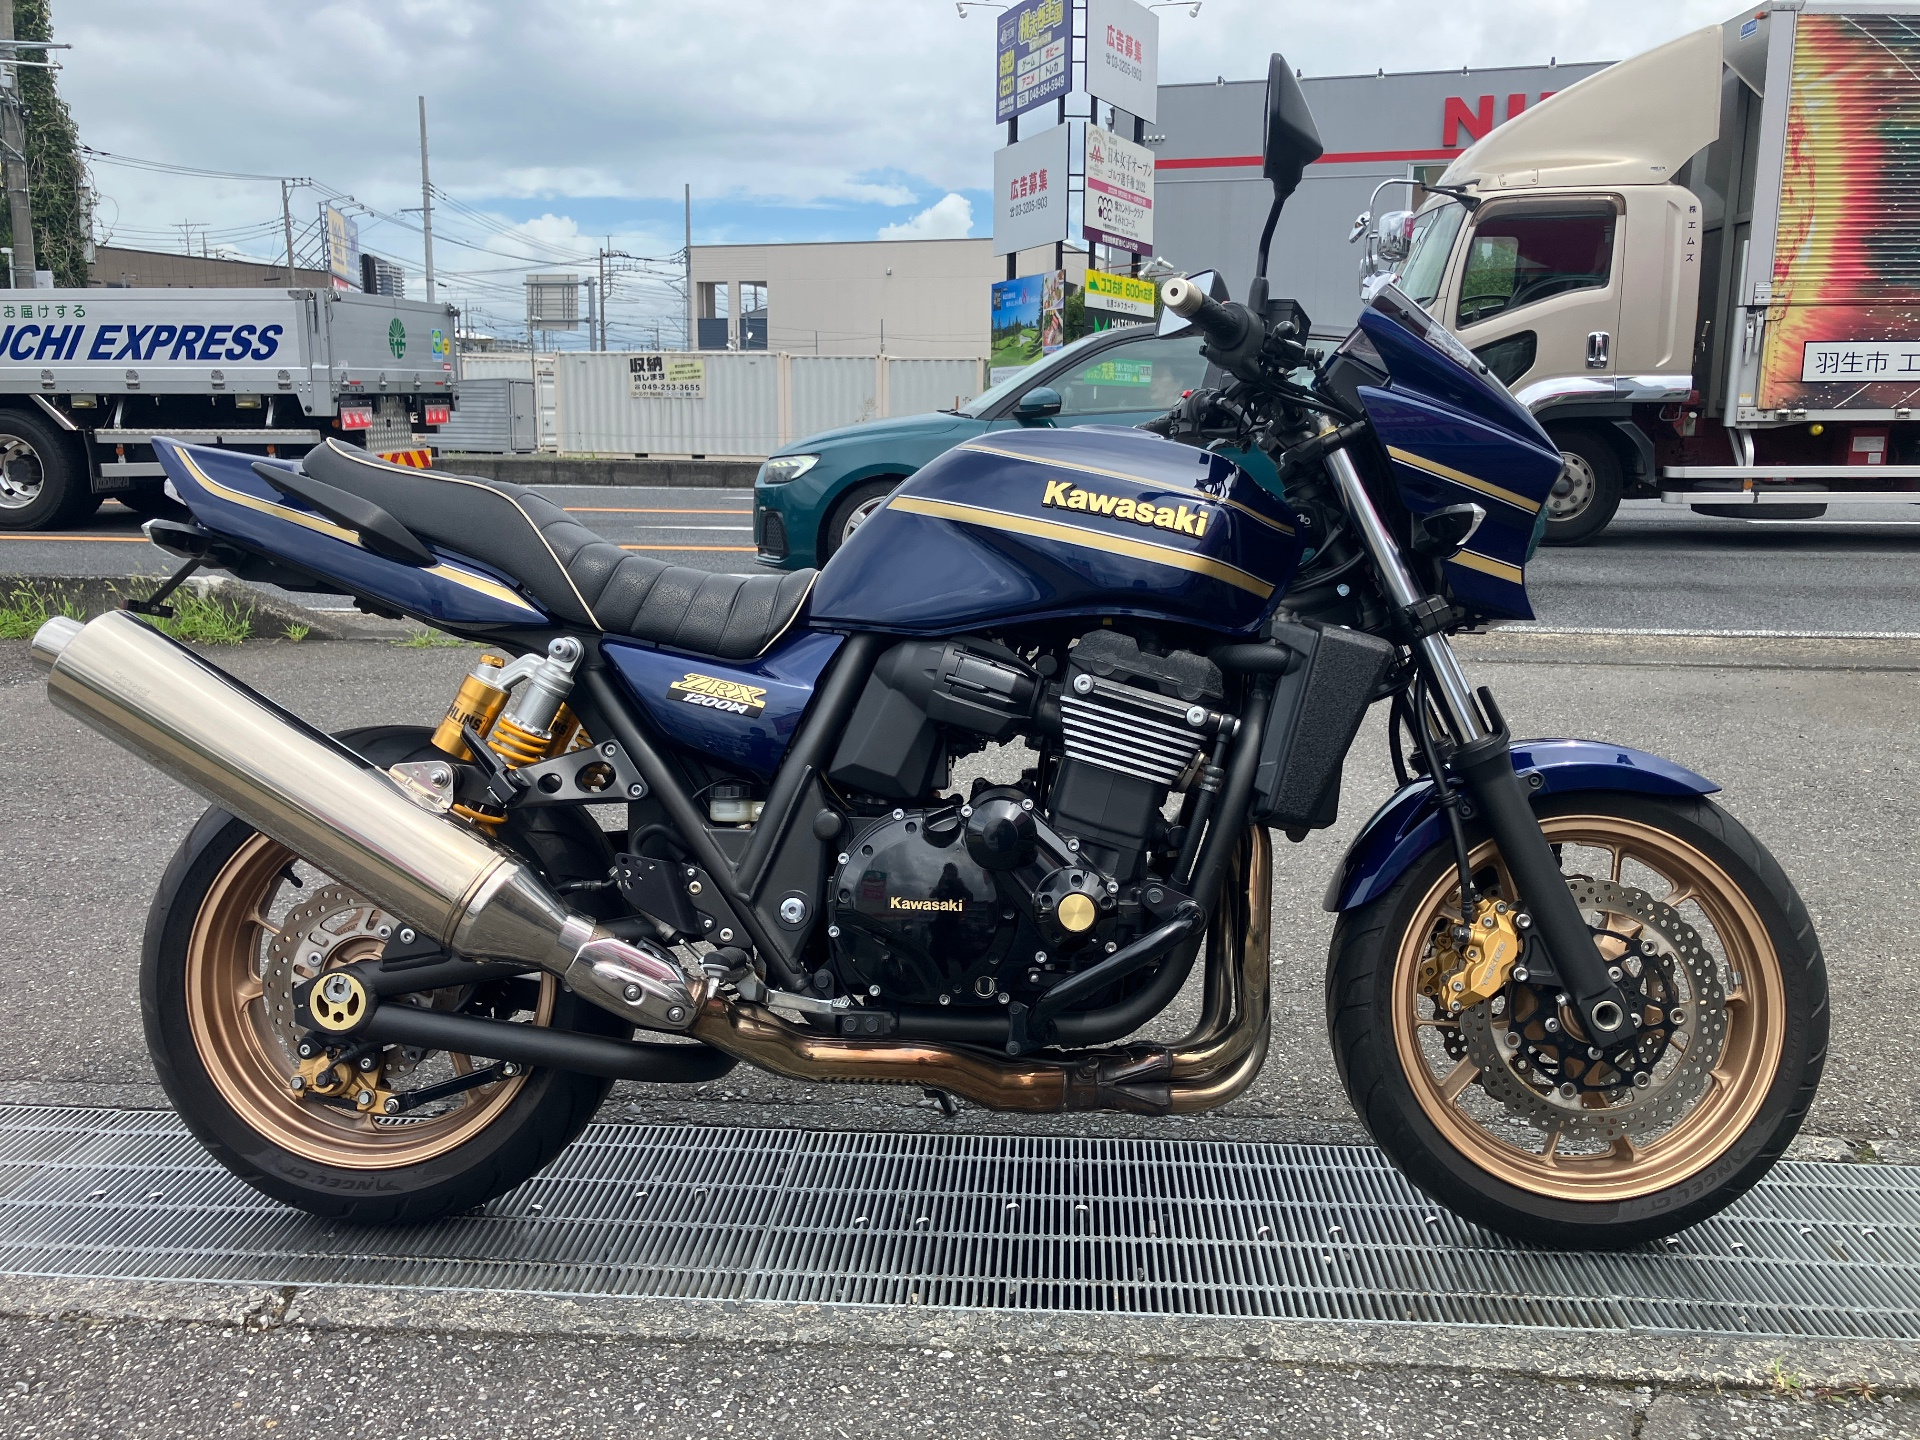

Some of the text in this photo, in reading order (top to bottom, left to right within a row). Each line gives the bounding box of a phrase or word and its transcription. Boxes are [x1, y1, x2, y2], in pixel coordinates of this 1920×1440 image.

[1106, 24, 1142, 64] 広告募集
[1021, 57, 1036, 72] ゲーム
[1045, 61, 1059, 77] トレカ
[1021, 73, 1036, 89] アニメ
[1108, 147, 1153, 178] 日本女子オープン
[1010, 168, 1048, 201] 広告募集
[3, 304, 86, 319] お届けする
[87, 324, 284, 361] EXPRESS
[629, 355, 663, 374] 収納
[1815, 351, 1890, 374] 羽生市
[633, 373, 665, 383] 貸します
[641, 383, 701, 392] 049-253-3655
[1041, 480, 1209, 539] Kawasaki
[678, 673, 767, 706] ZRX
[446, 704, 483, 731] HLINS
[890, 896, 963, 912] Kawasaki
